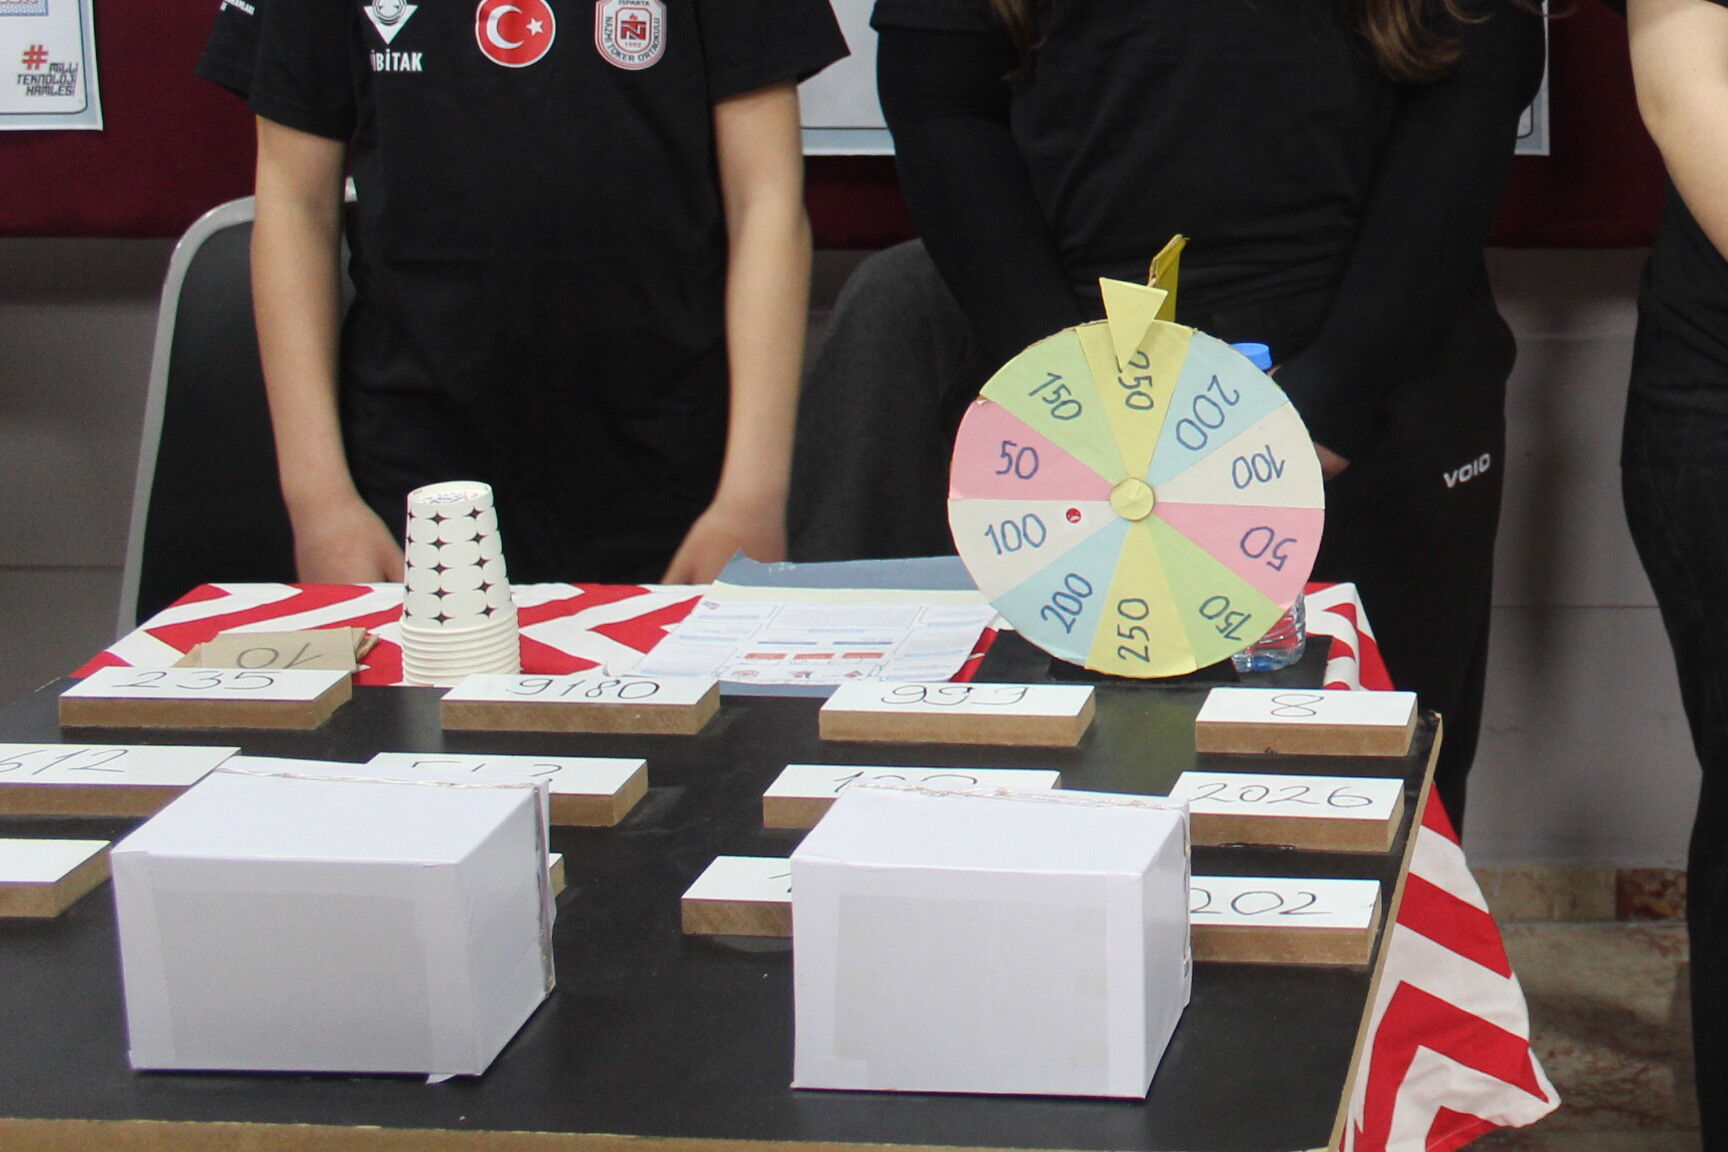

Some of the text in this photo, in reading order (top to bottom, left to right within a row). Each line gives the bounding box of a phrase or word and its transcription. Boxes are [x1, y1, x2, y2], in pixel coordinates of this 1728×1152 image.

[1028, 371, 1083, 422] 150
[1175, 373, 1241, 452] 200
[994, 439, 1040, 481] 50
[1230, 444, 1286, 490] 100
[1442, 453, 1491, 488] VOID
[984, 512, 1048, 556] 100
[1239, 524, 1298, 572] 50
[1040, 572, 1094, 635] 200
[1198, 594, 1253, 642] 150
[1116, 597, 1151, 664] 250
[111, 670, 284, 691] 235
[504, 677, 661, 700] 9180
[1269, 693, 1325, 718] 8
[1188, 781, 1374, 809] 2026
